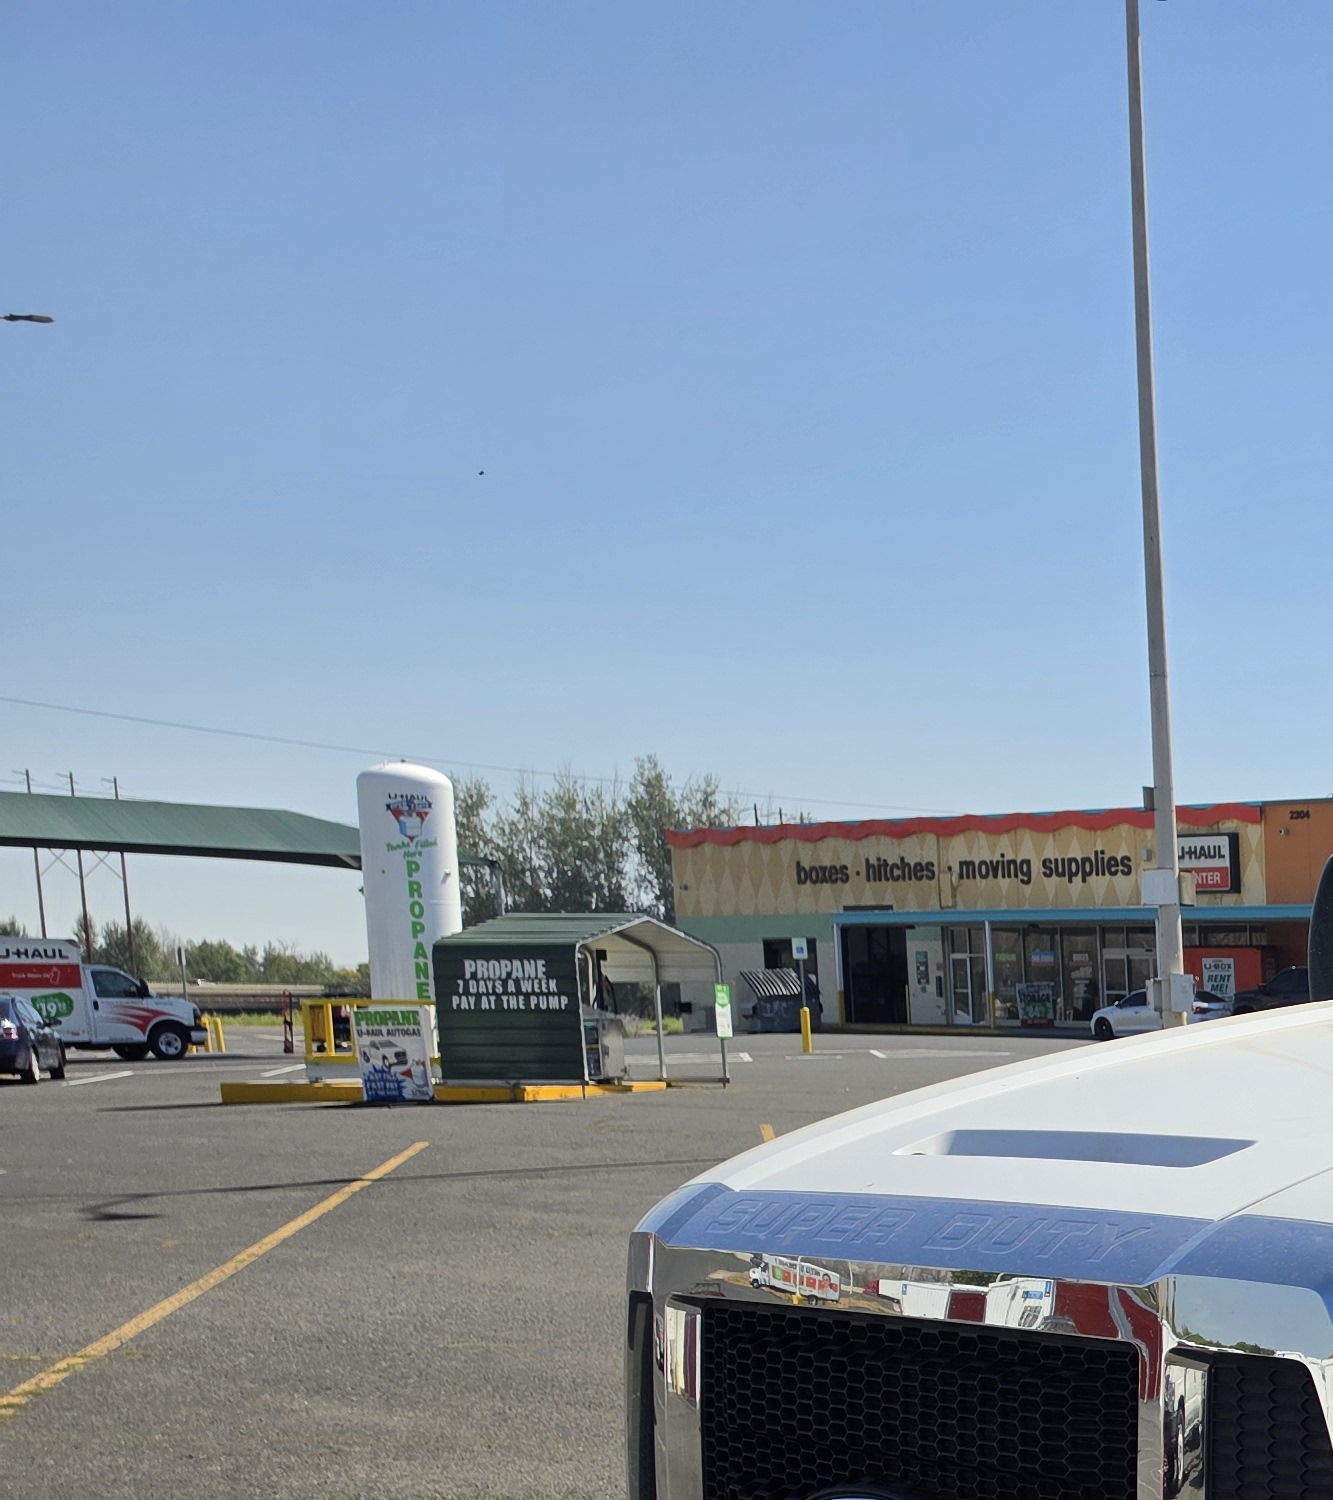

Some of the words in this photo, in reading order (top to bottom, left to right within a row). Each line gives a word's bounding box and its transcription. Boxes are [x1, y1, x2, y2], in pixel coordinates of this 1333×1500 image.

[1290, 810, 1310, 820] 2304
[796, 861, 849, 885] boxes
[865, 856, 935, 883] hitches
[958, 853, 1031, 885] moving
[1042, 850, 1132, 884] supplies
[1197, 872, 1221, 885] NTER
[406, 860, 431, 1000] PROPANE
[463, 959, 546, 979] PROPANE
[1207, 973, 1232, 983] RENT
[457, 980, 463, 994] 7
[469, 979, 503, 994] DAYS
[507, 979, 516, 993] A
[520, 979, 558, 993] WEEK
[452, 995, 476, 1010] PAY
[481, 995, 497, 1010] AT
[502, 995, 526, 1010] THE
[530, 995, 569, 1010] PUMP
[353, 1010, 420, 1027] PROPANE
[706, 1199, 916, 1246] SUPER
[921, 1212, 1154, 1263] DUTY
